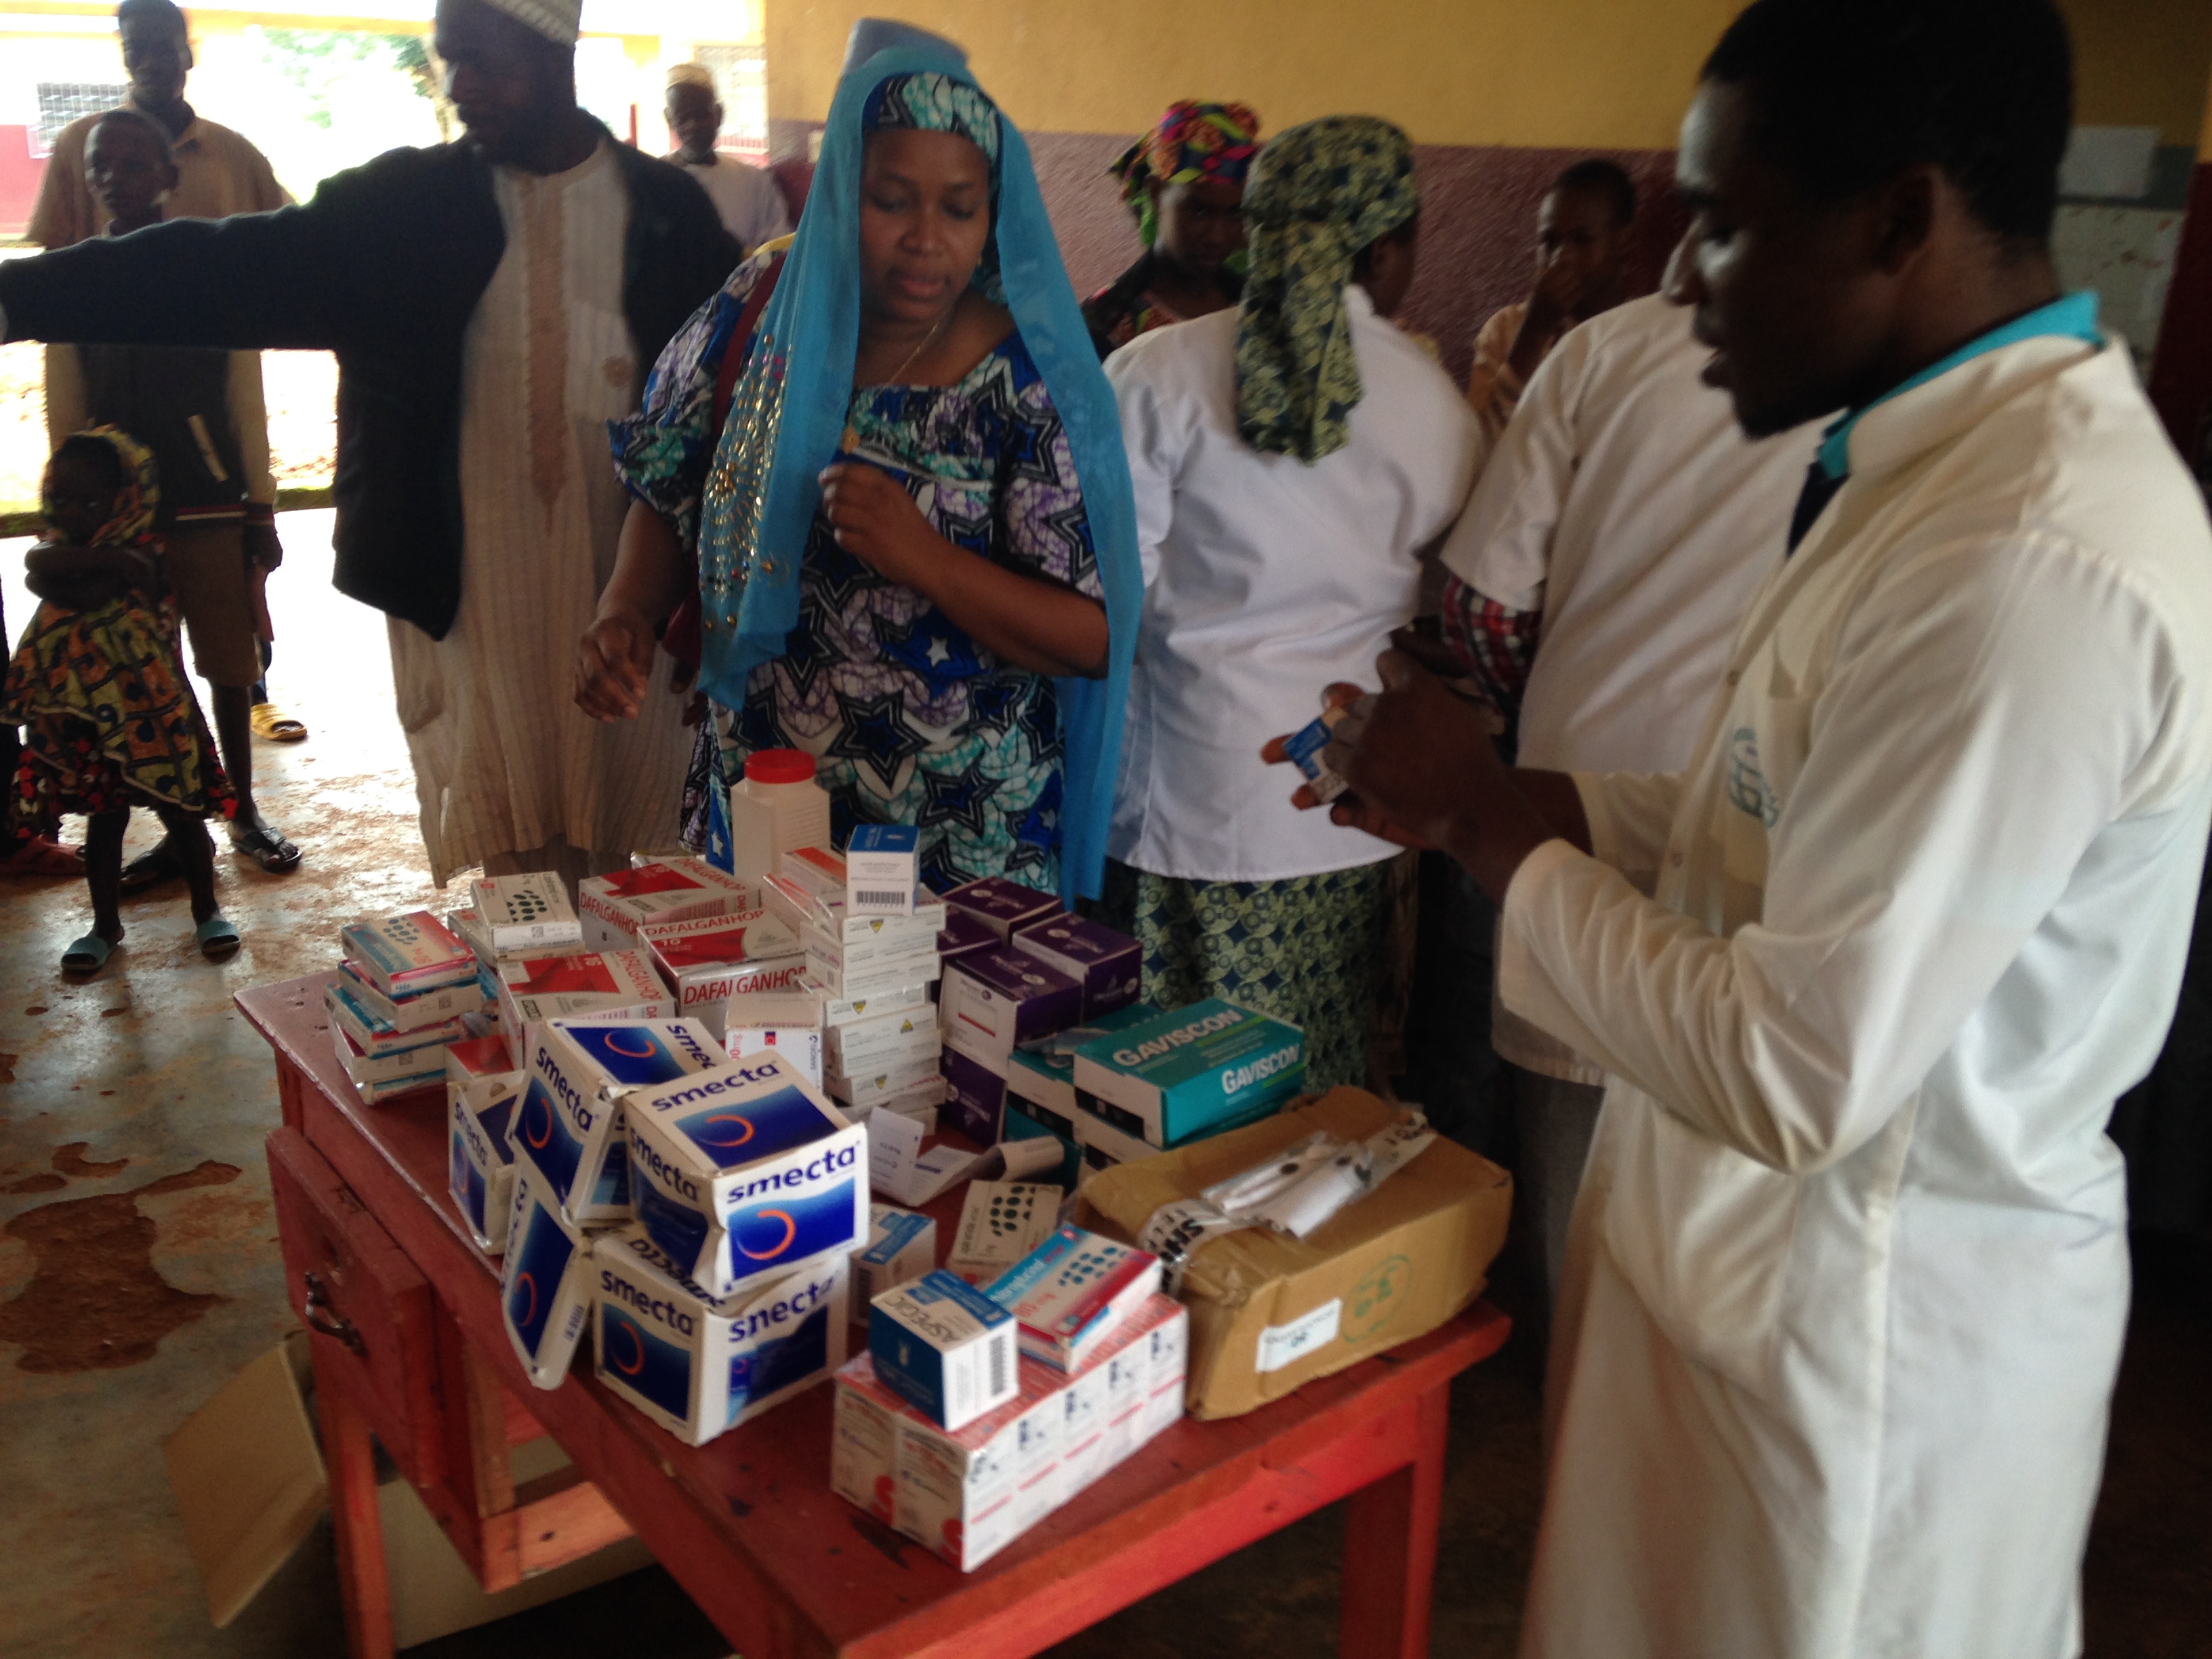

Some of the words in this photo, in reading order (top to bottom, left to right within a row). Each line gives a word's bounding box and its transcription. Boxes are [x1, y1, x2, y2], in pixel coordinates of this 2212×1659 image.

[645, 910, 764, 936] DAFALGANHOP
[1113, 1008, 1244, 1067] GAVISCON
[535, 1046, 593, 1132] smecta
[651, 1062, 780, 1112] smecta
[1222, 1042, 1300, 1095] GAVISCON
[630, 1126, 699, 1203] smecta
[726, 1146, 856, 1205] smecta
[600, 1269, 693, 1337] smecta
